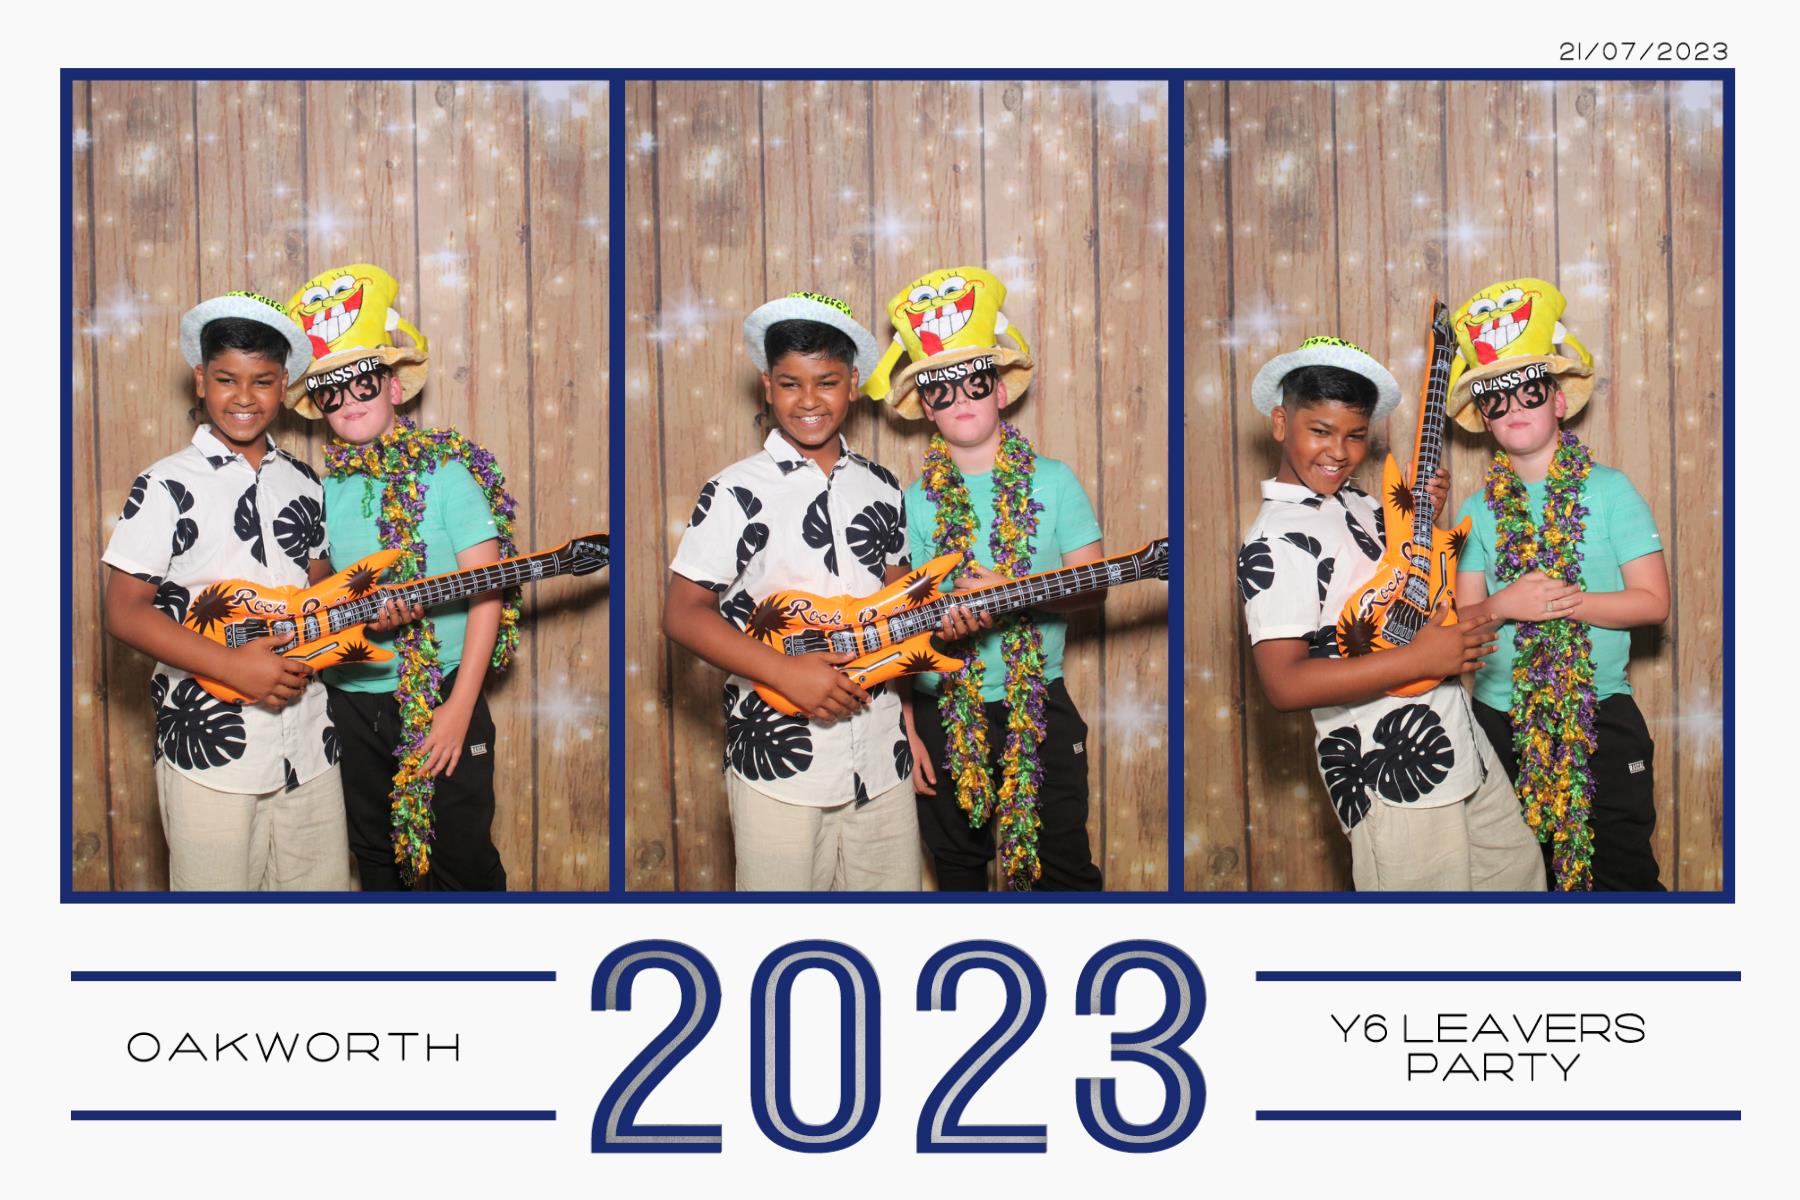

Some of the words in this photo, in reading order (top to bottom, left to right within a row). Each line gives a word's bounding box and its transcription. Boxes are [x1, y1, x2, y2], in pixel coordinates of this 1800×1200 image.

[305, 364, 354, 391] CLASS
[357, 357, 380, 374] OF
[915, 362, 968, 387] CLASS
[972, 356, 994, 373] OF
[1471, 370, 1521, 397] CLASS
[1524, 363, 1548, 380] OF
[232, 588, 287, 615] Rock
[1359, 568, 1405, 619] Rock
[787, 599, 842, 625] Rock
